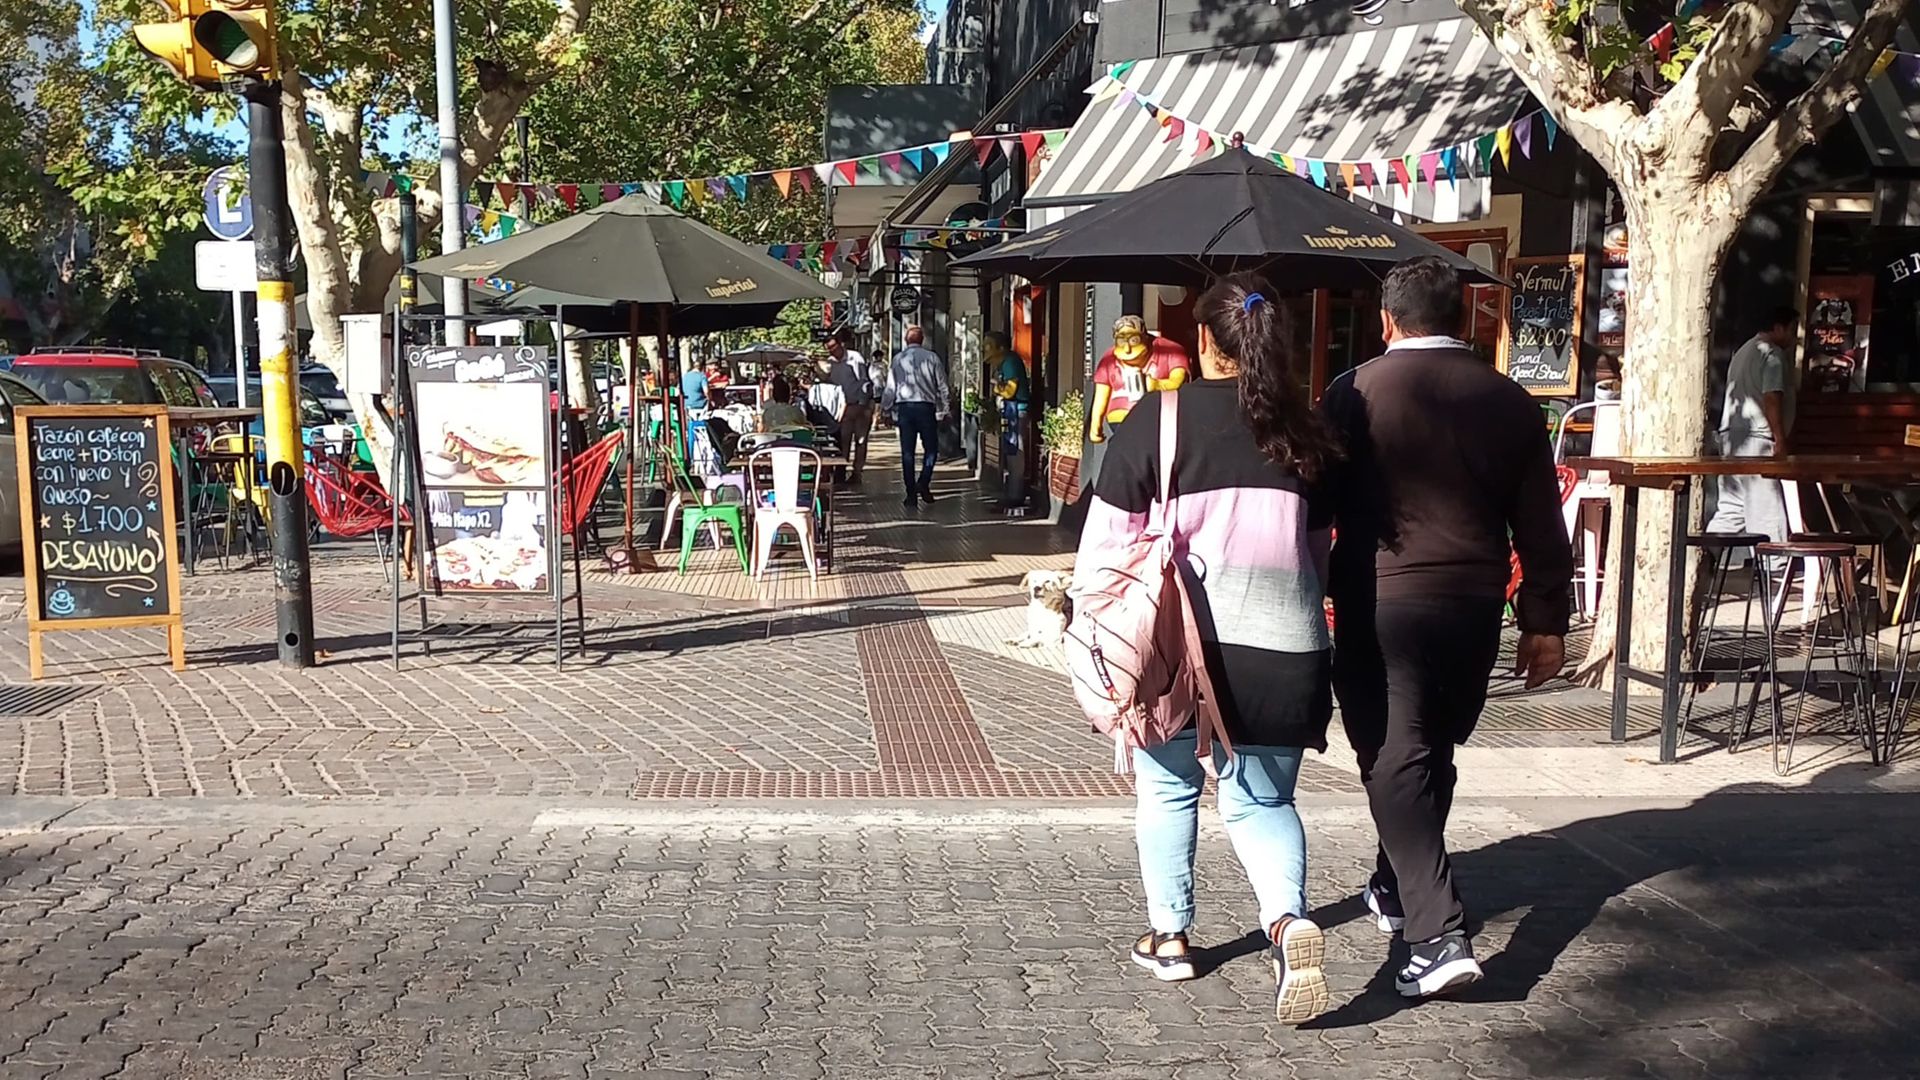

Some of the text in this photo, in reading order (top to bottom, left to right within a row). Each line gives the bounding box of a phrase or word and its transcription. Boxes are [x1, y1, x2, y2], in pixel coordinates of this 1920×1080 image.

[1302, 234, 1397, 251] Imperial
[705, 278, 757, 300] Imperial
[1515, 265, 1573, 293] Vermut
[1515, 326, 1566, 350] $2800
[1514, 349, 1545, 364] and
[33, 424, 146, 449] Tazón café con
[36, 464, 65, 484] con
[69, 463, 112, 487] huevo
[42, 485, 92, 505] Queso
[42, 540, 156, 574] DESAYUNO
